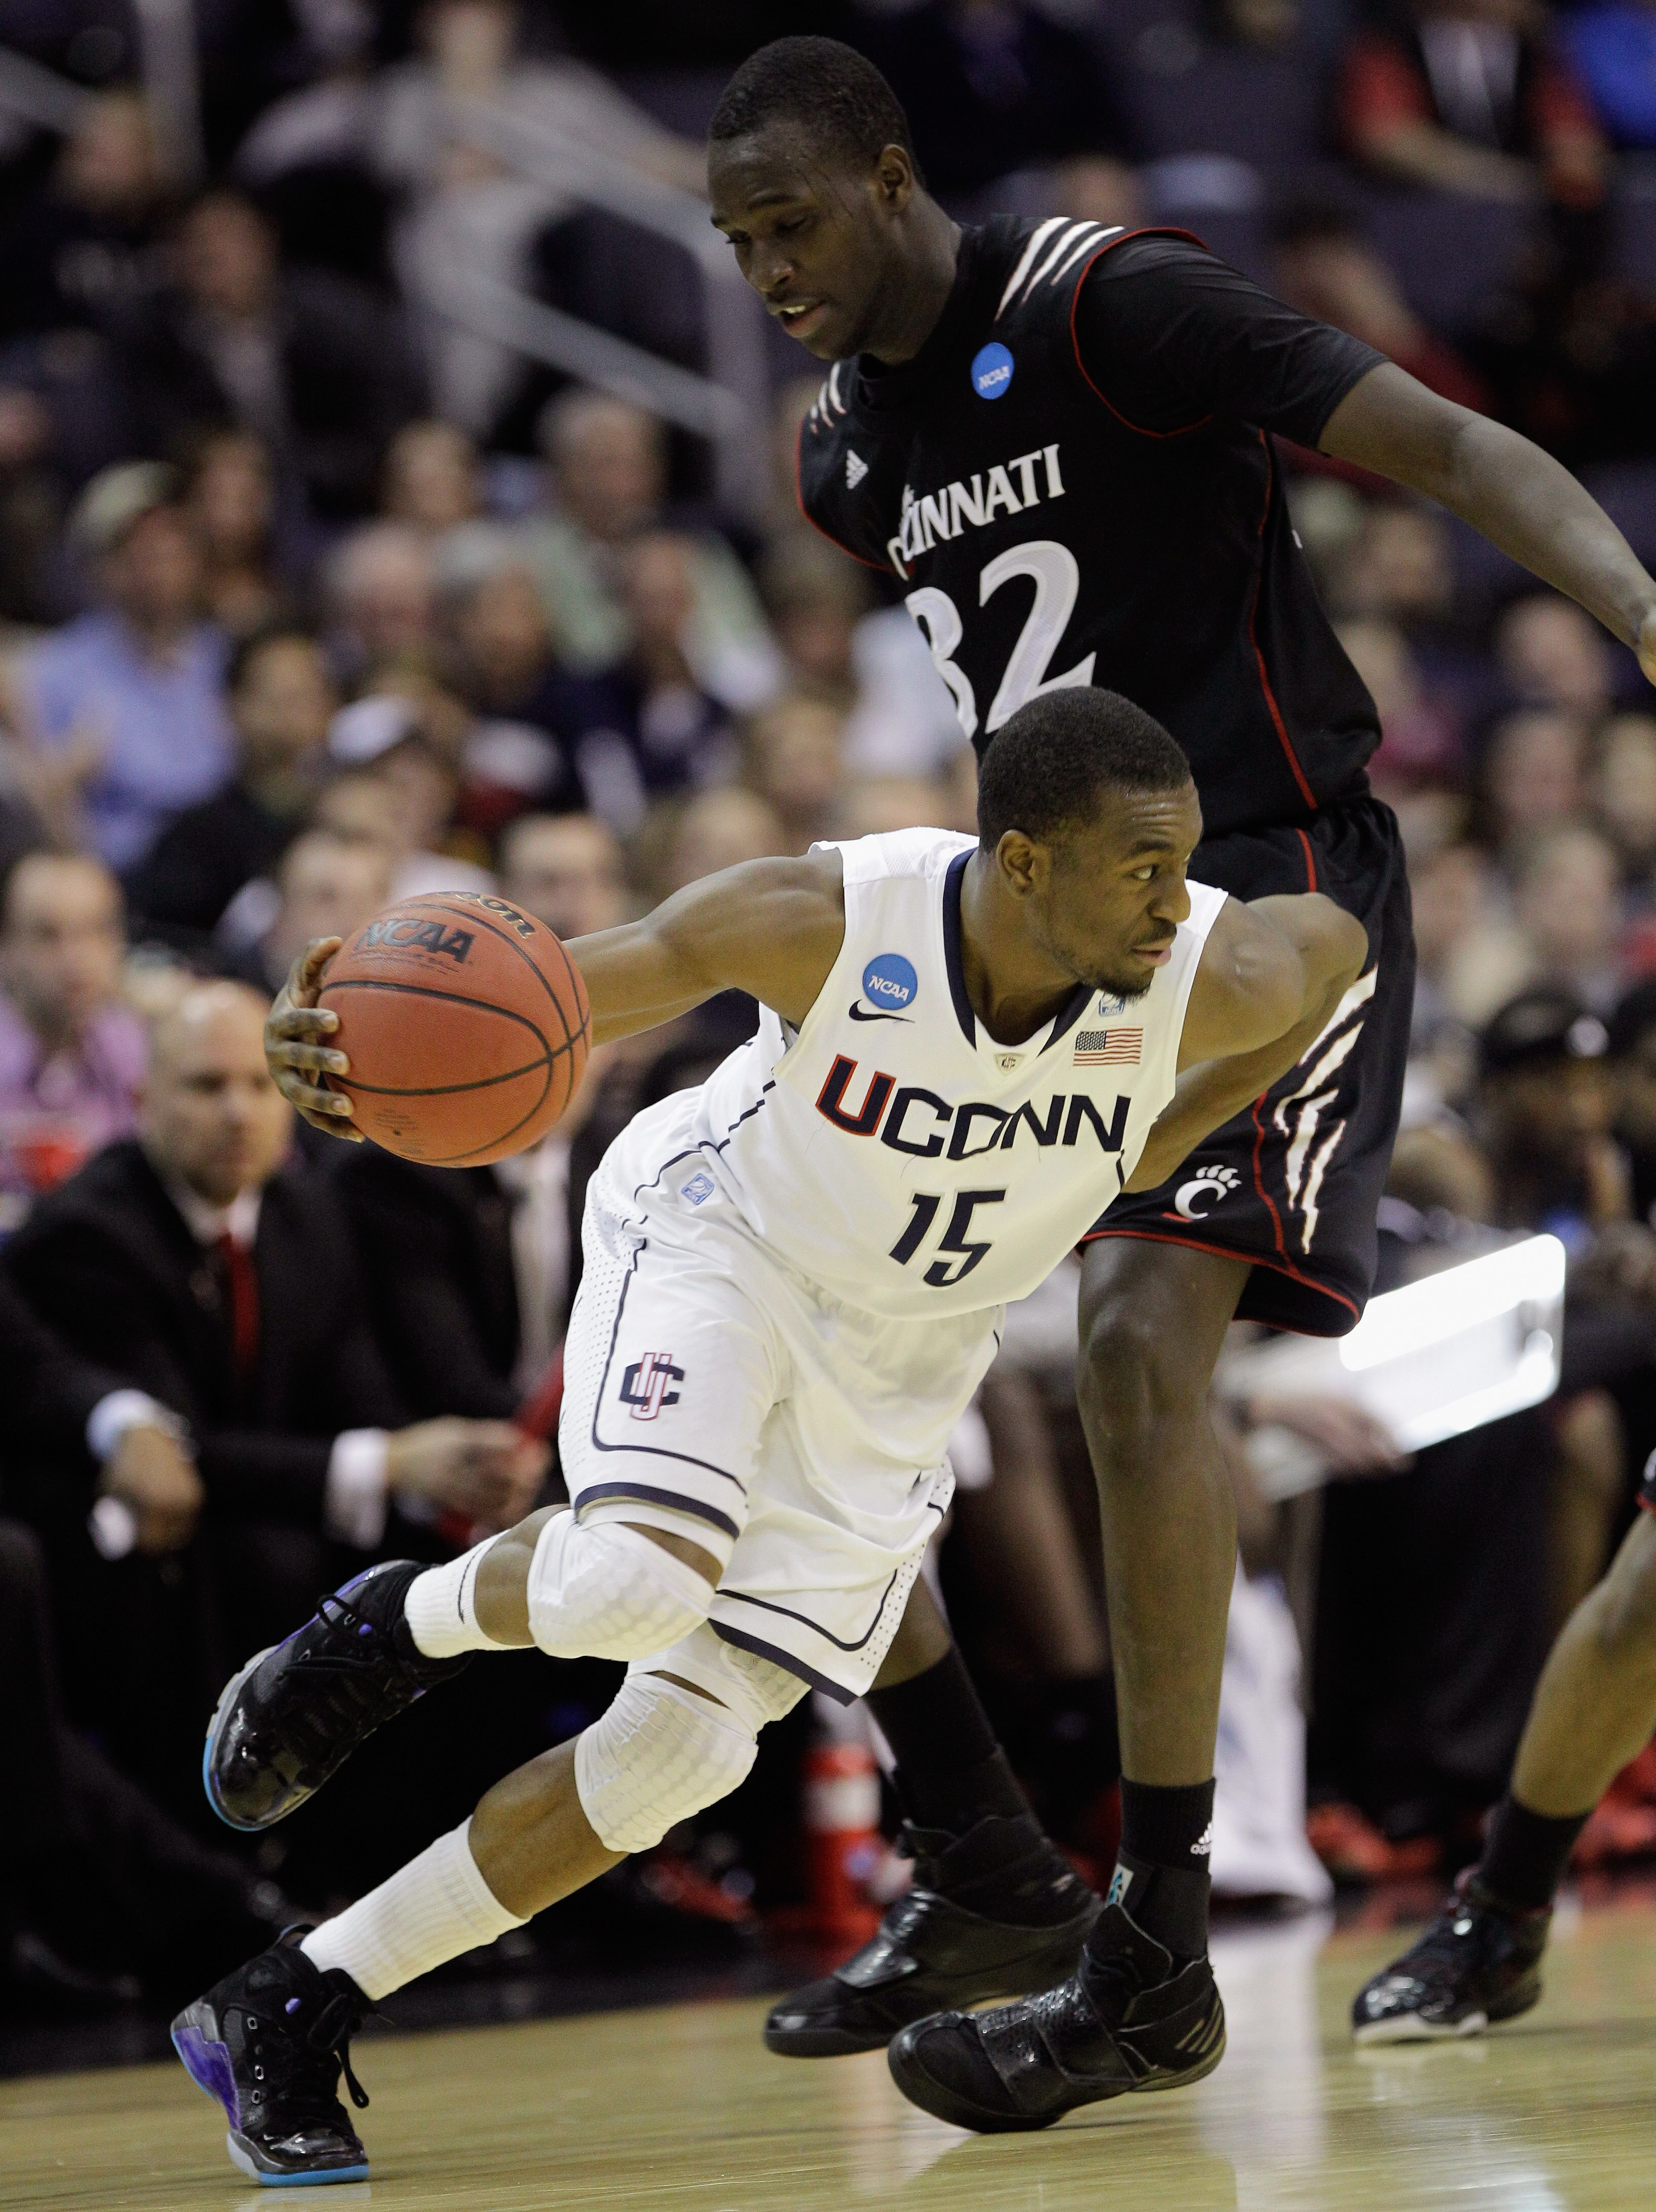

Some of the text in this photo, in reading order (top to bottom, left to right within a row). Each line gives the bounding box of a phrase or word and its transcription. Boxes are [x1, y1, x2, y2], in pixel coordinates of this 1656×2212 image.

[978, 365, 1010, 390] NCAA
[352, 918, 476, 963] NCAA
[868, 974, 910, 1003] NCAA
[814, 1054, 1132, 1162] UCONN
[888, 1186, 1007, 1288] 15
